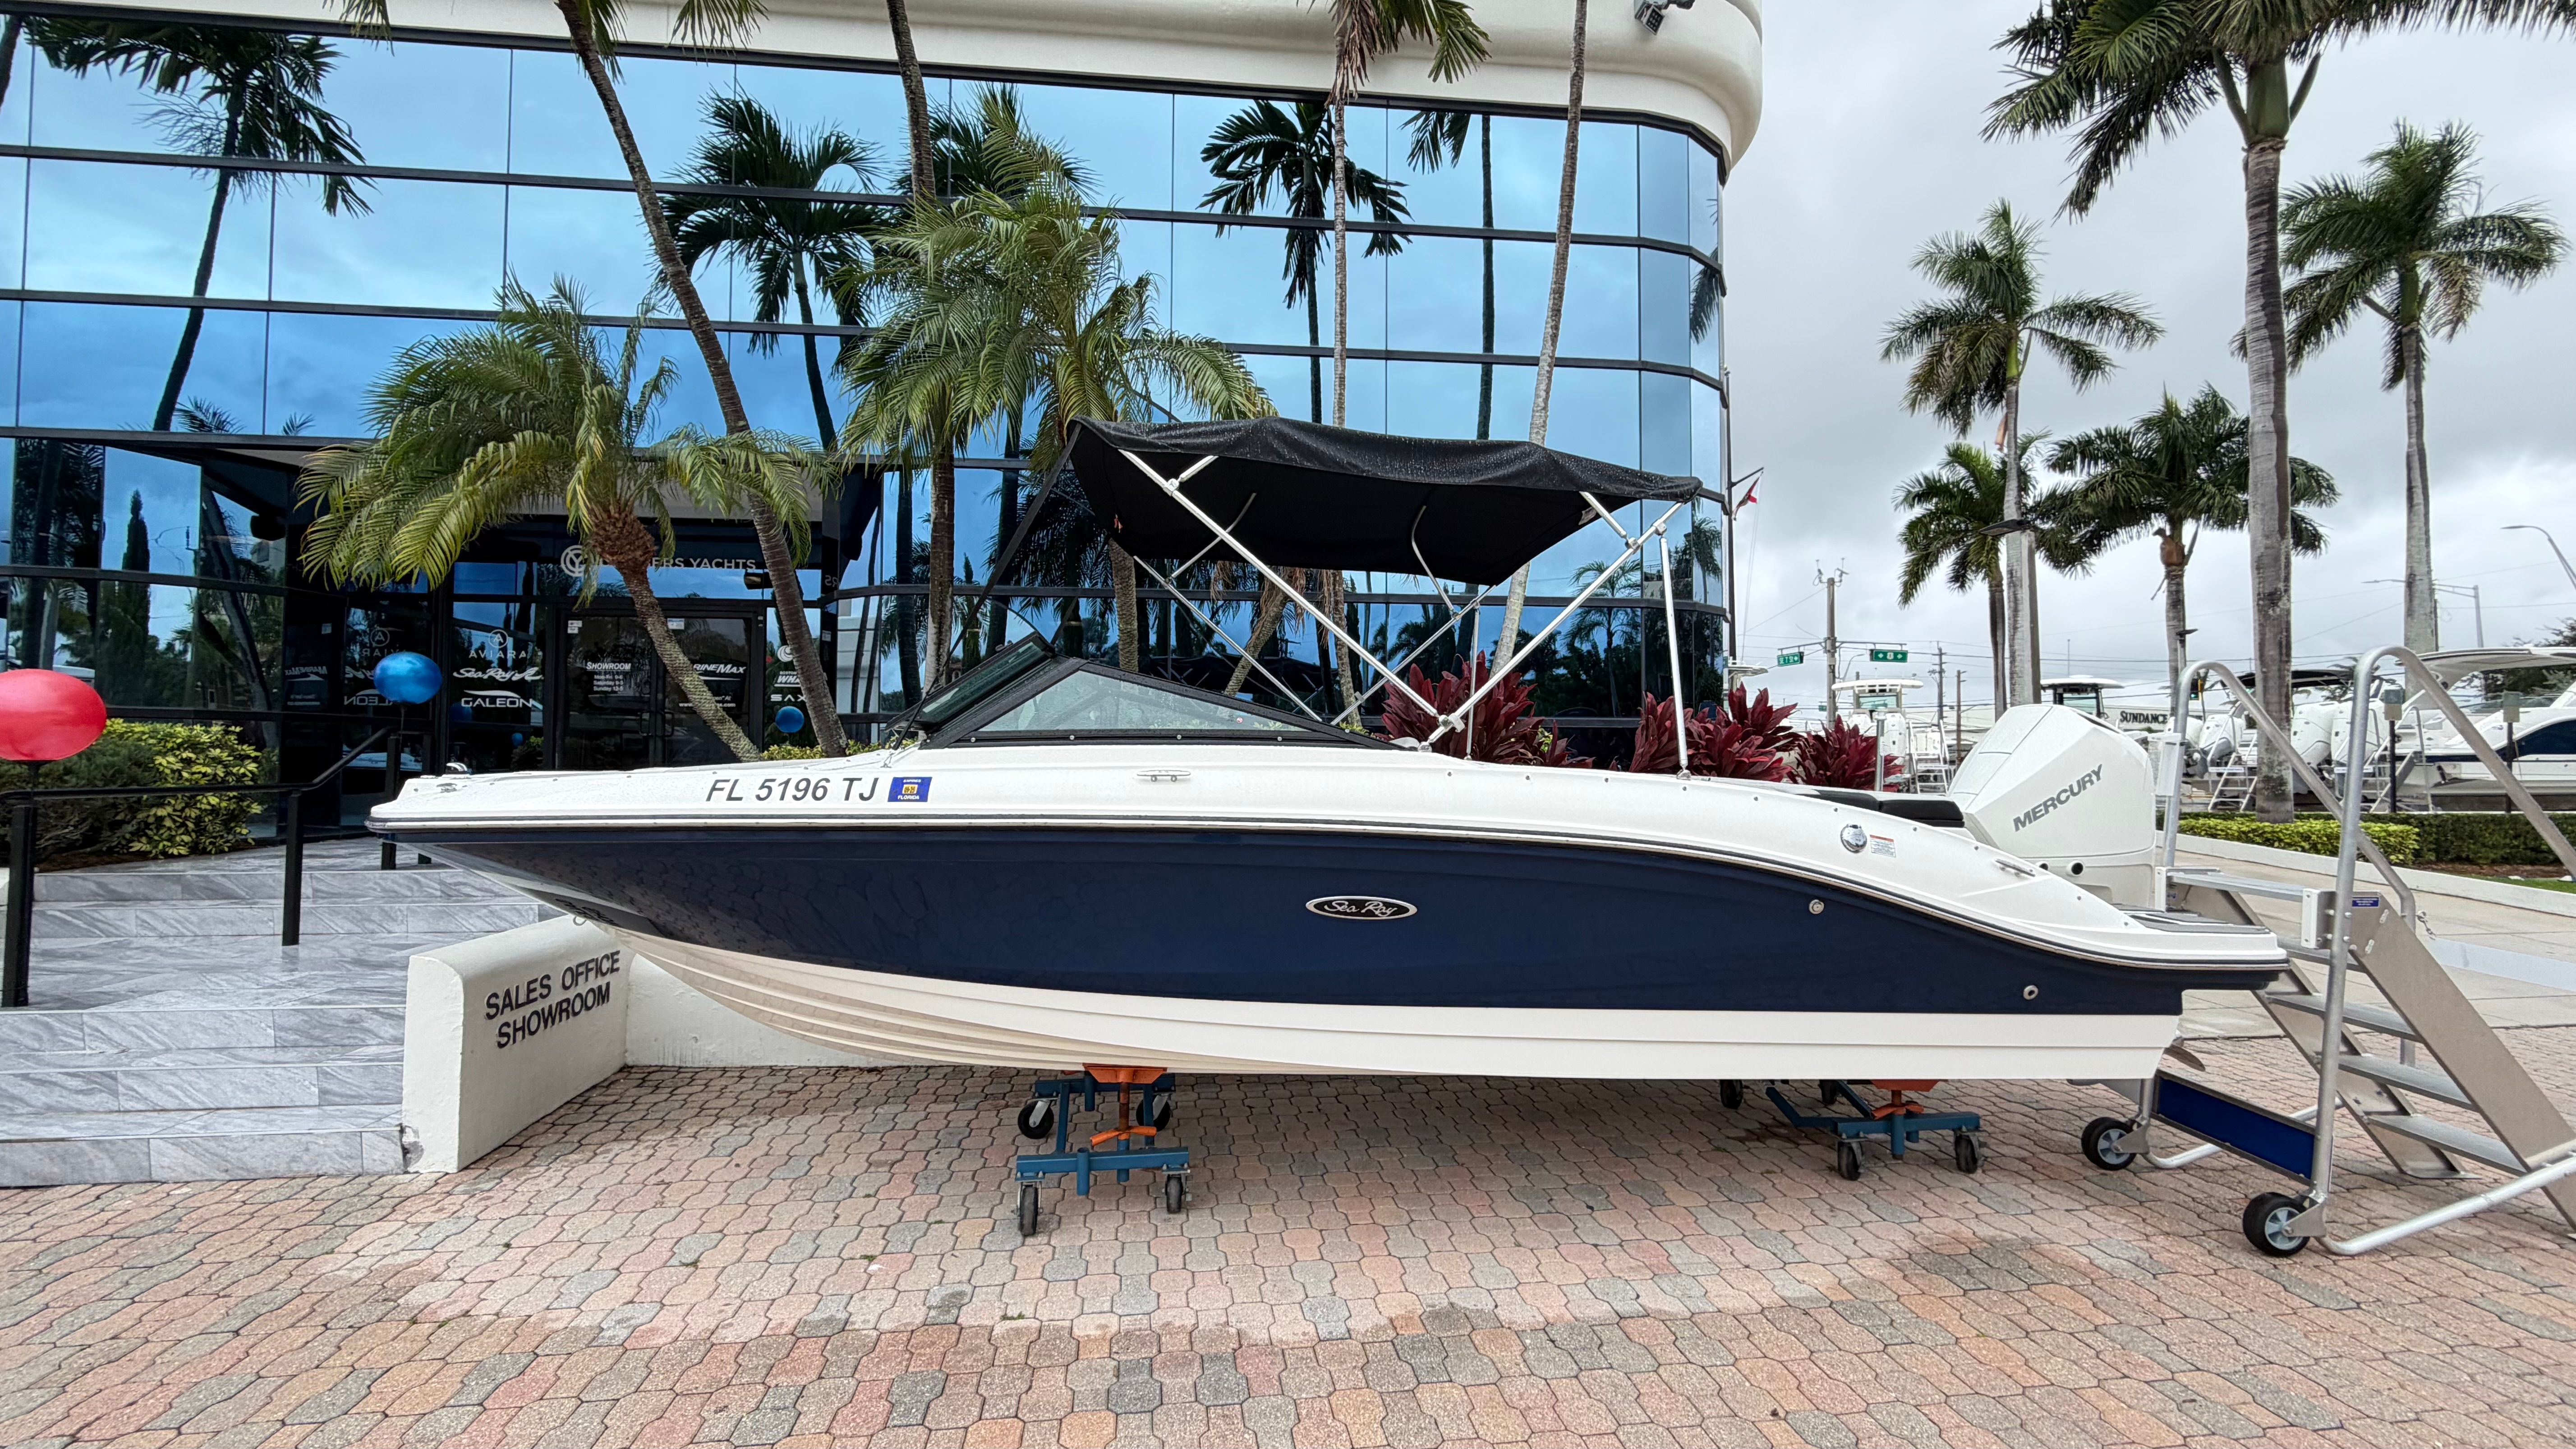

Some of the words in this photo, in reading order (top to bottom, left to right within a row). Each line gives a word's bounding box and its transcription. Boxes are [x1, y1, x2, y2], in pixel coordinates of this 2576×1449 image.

[690, 558, 756, 570] YACHTS
[469, 650, 527, 659] AVIARA
[586, 662, 631, 670] SHOWROOM
[693, 663, 747, 673] RINEMAX
[461, 698, 532, 708] GALEON
[2120, 710, 2168, 724] SUNDANCE
[705, 778, 744, 802] FL
[755, 777, 830, 801] 5196
[842, 777, 879, 801] TJ
[2013, 764, 2102, 832] MERCURY
[1324, 900, 1360, 913] Sea
[1361, 901, 1398, 917] Ray
[485, 974, 552, 1020] SALES
[561, 950, 621, 990] OFFICE
[497, 981, 611, 1049] SHOWROOM
